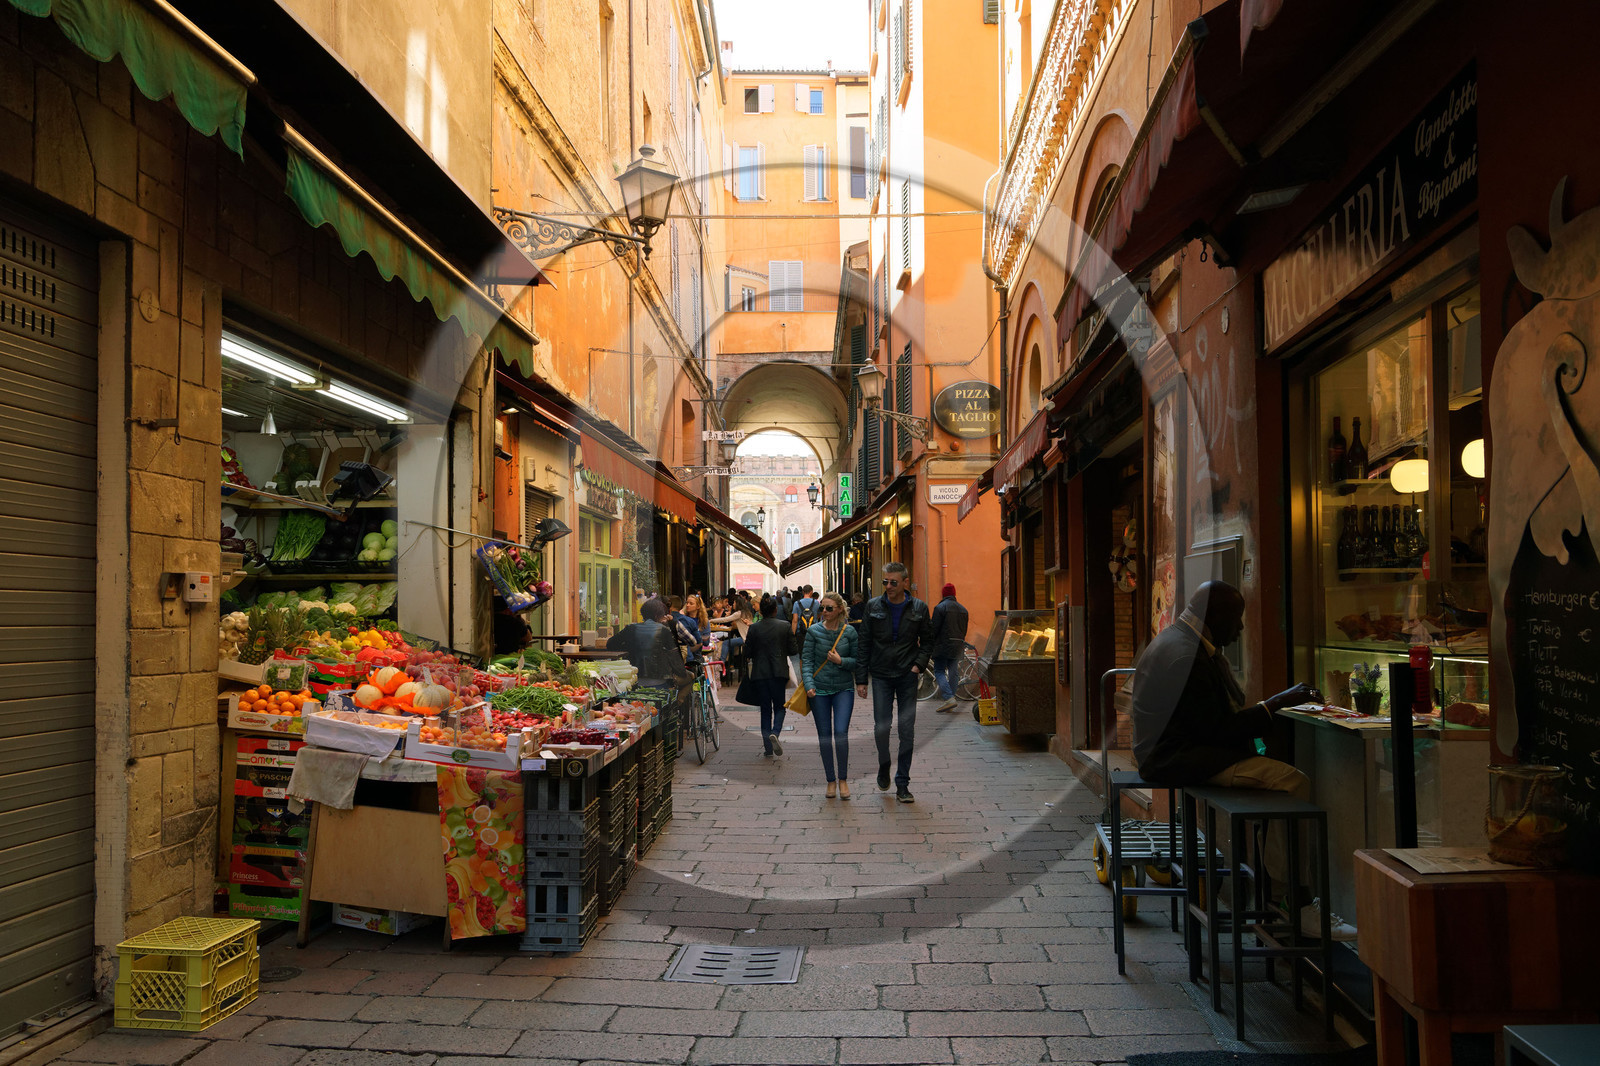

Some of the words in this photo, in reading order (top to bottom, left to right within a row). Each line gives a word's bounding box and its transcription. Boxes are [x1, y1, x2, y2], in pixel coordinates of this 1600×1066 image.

[1443, 130, 1457, 169] &
[1417, 143, 1478, 220] Bignami
[1263, 154, 1411, 350] MACELLERIA
[955, 389, 991, 399] PIZZA
[965, 401, 982, 411] AL
[949, 412, 996, 422] TAGLIO
[1524, 587, 1587, 612] Hamburger
[232, 871, 259, 880] Princess
